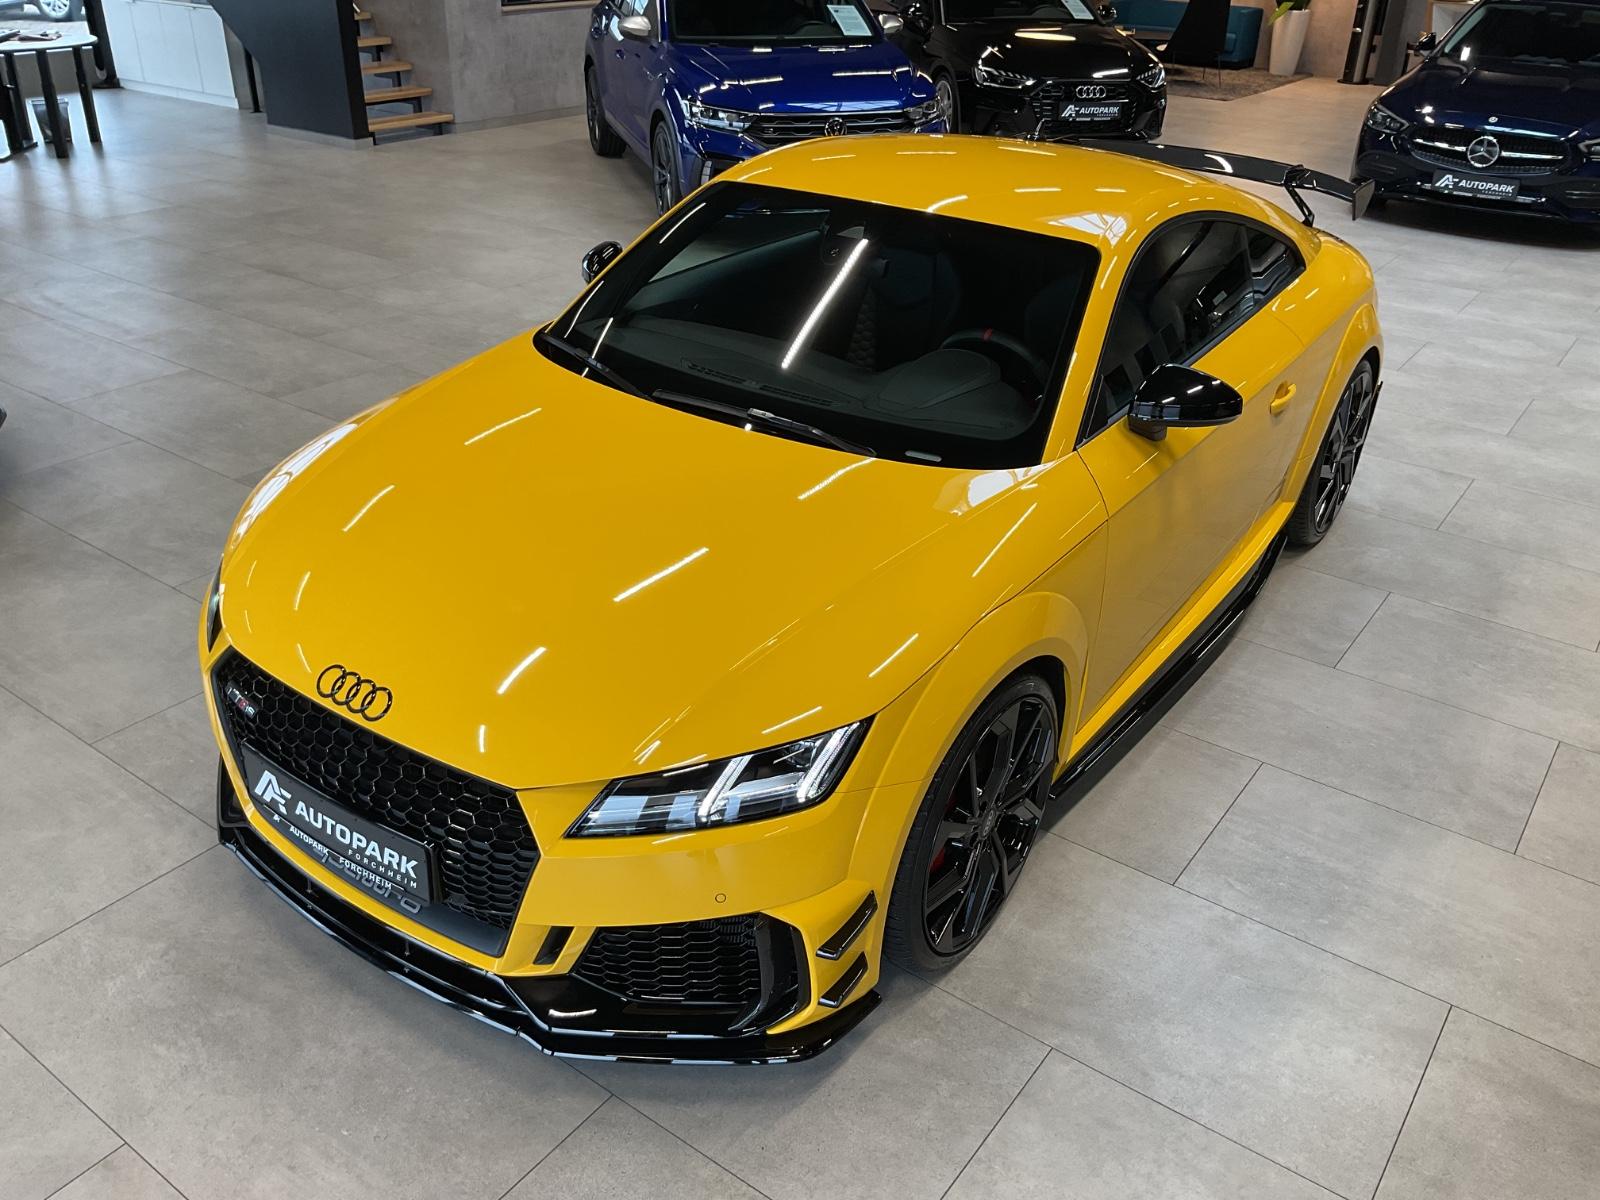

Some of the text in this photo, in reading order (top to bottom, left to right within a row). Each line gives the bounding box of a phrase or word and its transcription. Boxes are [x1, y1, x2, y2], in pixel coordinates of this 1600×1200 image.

[1079, 106, 1120, 114] AUTOPARK
[1458, 180, 1516, 193] AUTOPARK
[289, 825, 393, 890] AUTOPARK FORCHHEIM
[295, 800, 418, 879] AUTOPARK
[348, 849, 417, 889] FORCHHEIM
